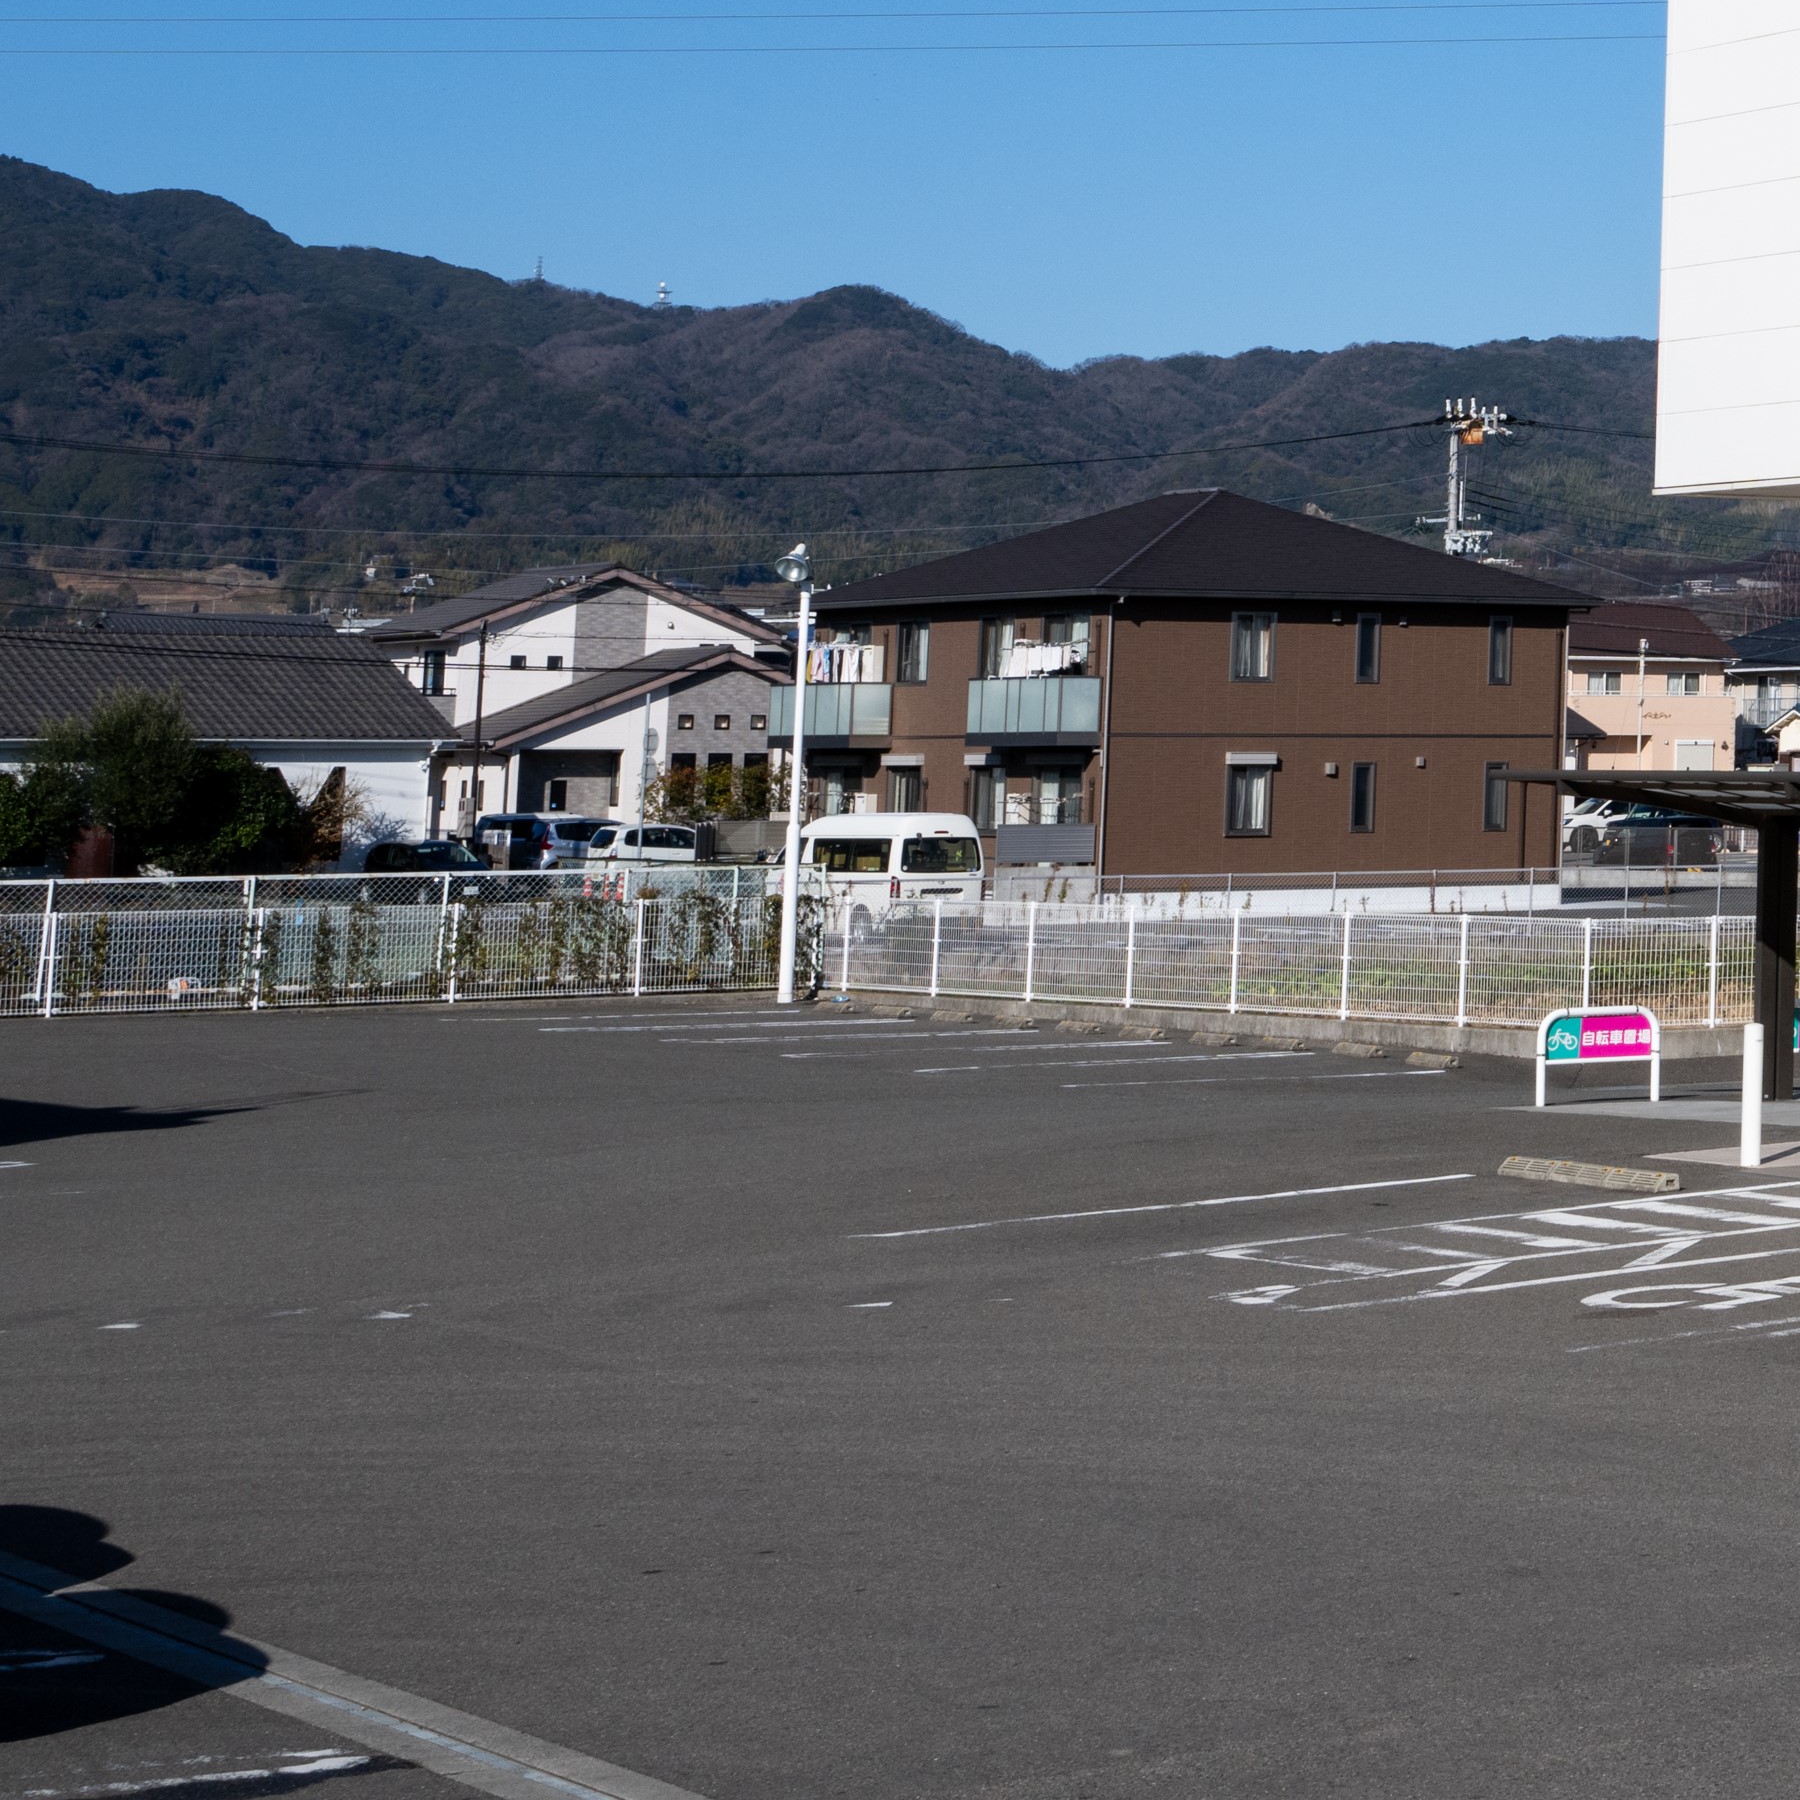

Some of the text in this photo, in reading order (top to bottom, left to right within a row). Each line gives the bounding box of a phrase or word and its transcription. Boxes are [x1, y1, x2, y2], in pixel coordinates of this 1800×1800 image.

[1581, 1028, 1652, 1047] 自転車置場
